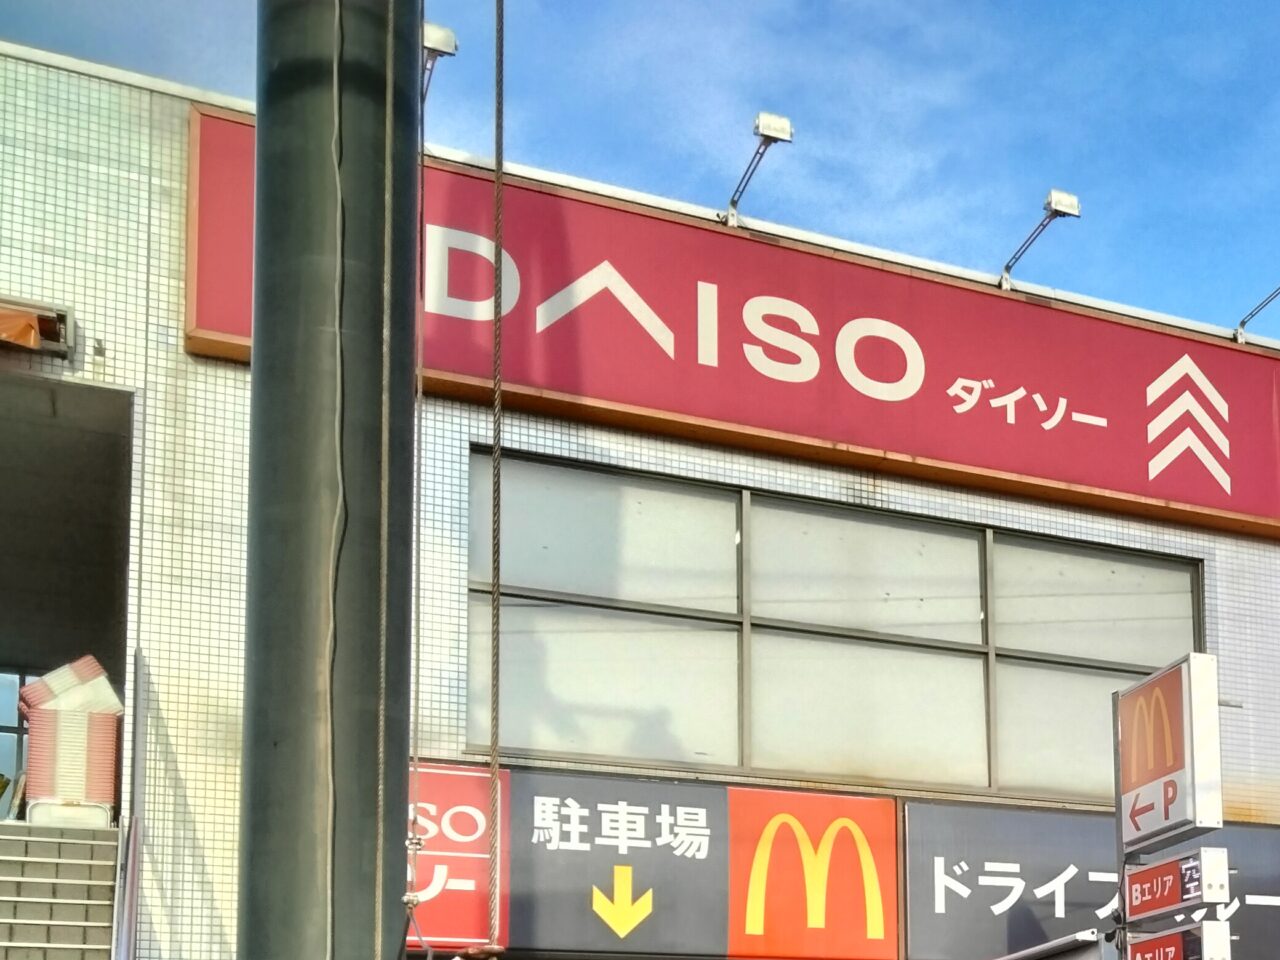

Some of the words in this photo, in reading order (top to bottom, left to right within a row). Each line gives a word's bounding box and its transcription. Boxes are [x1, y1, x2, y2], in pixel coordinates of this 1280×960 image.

[424, 224, 926, 401] DAISO
[946, 377, 1107, 430] ダイソー
[1163, 779, 1177, 821] P
[532, 796, 711, 859] 駐車場
[1132, 875, 1174, 906] Bエリア
